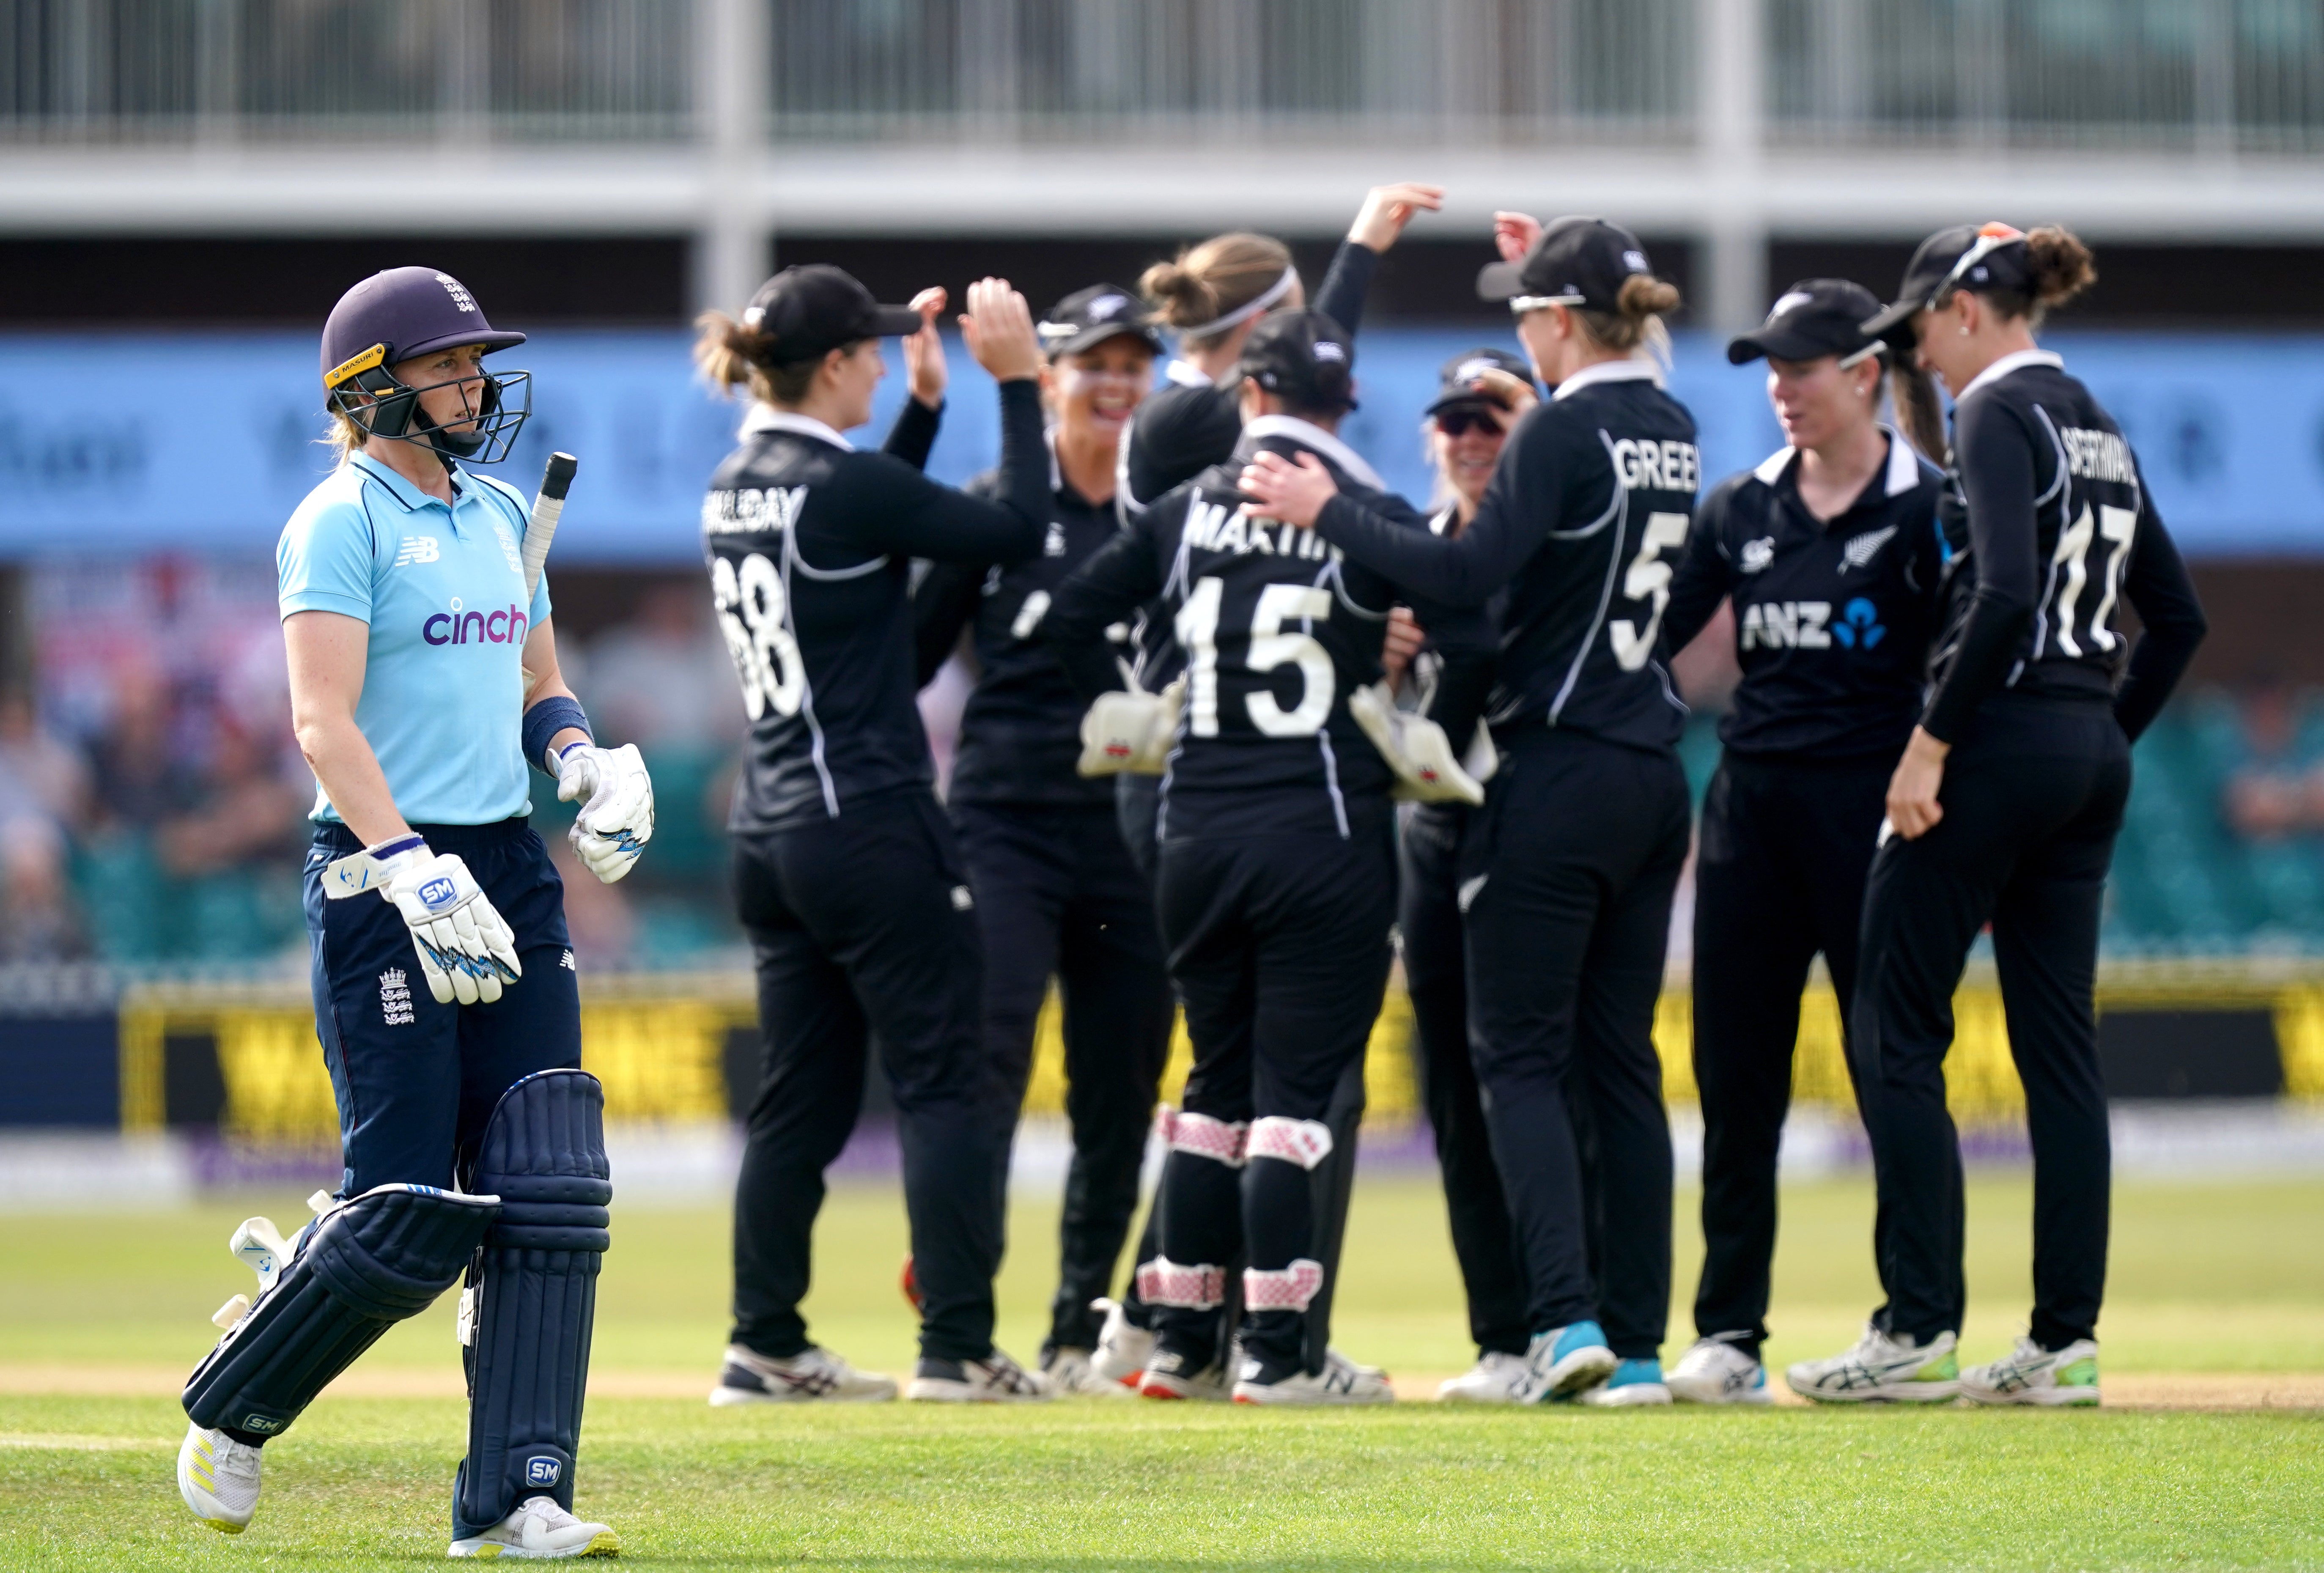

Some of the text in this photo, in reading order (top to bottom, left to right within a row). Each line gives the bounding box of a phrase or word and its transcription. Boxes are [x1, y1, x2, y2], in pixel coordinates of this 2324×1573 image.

[342, 351, 374, 372] MASURI
[1613, 439, 1701, 494] GREE
[1609, 512, 1689, 672] 5
[2054, 500, 2138, 658] 17
[423, 596, 527, 645] cinch
[1741, 601, 1832, 652] ANZ
[1176, 577, 1335, 738] 15
[422, 879, 453, 904] SM
[248, 1418, 280, 1430] SM
[531, 1462, 558, 1480] SM
